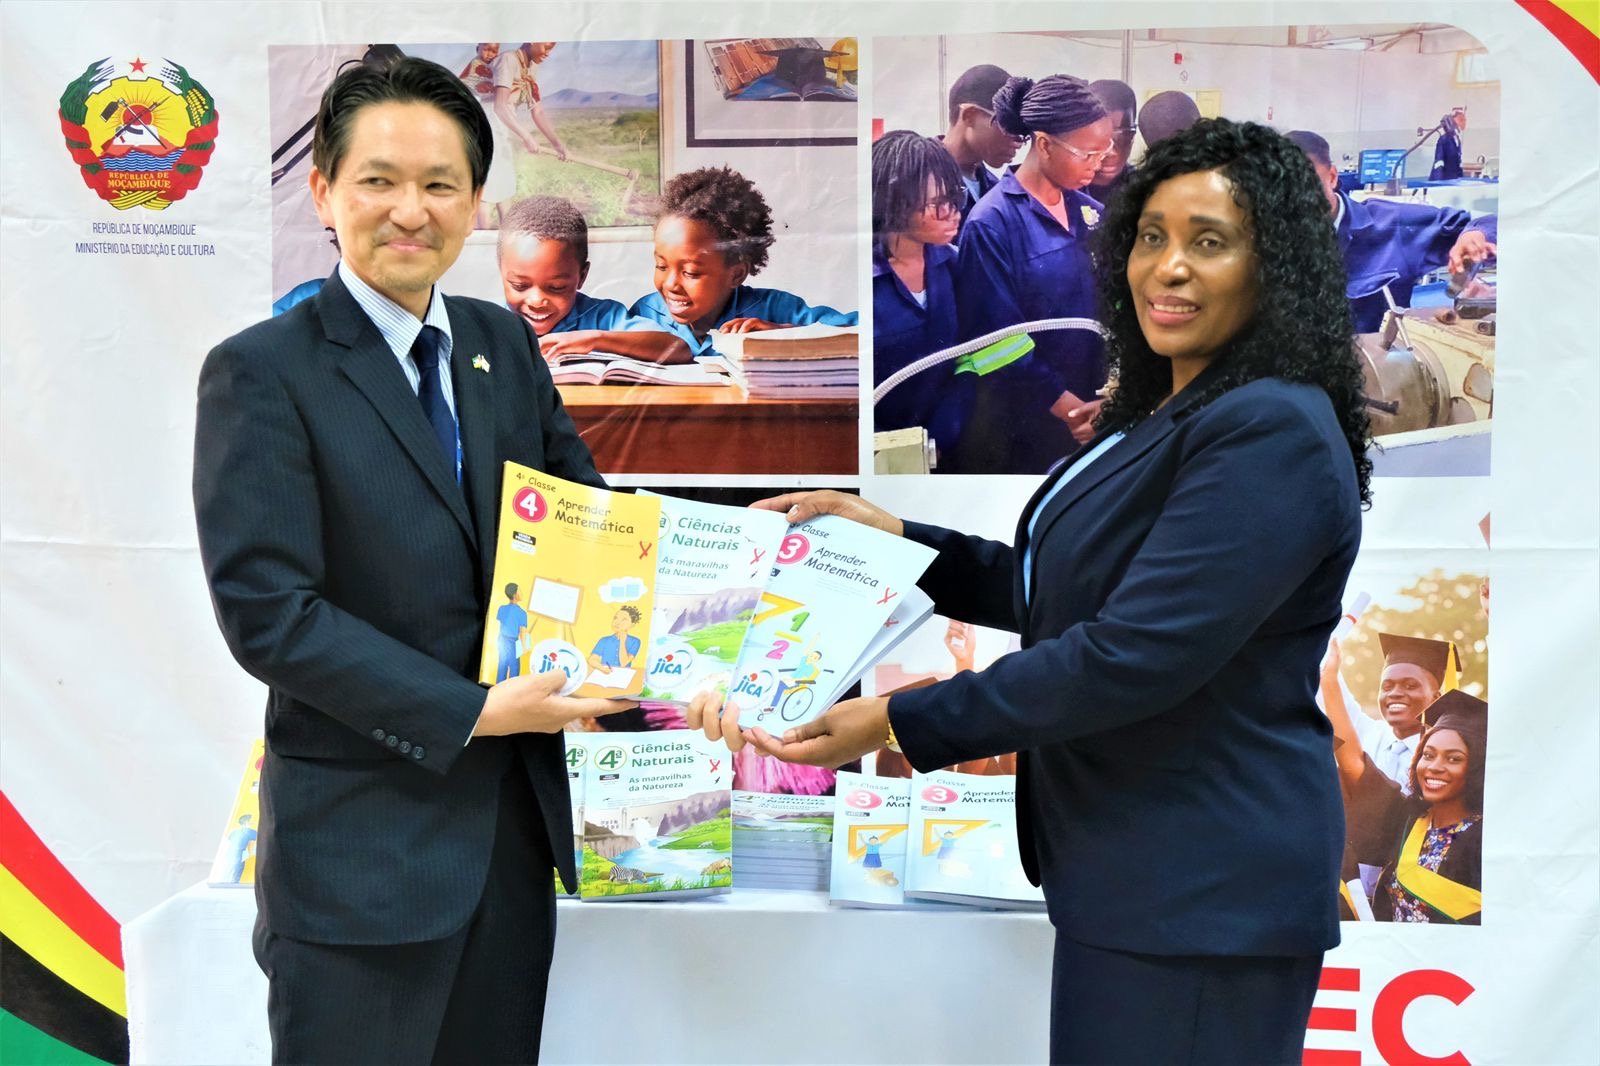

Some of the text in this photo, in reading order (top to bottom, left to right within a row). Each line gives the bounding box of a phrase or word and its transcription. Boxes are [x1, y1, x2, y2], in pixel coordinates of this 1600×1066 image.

[109, 171, 169, 180] REPÚBLICA DE
[107, 179, 171, 189] MOÇAMBIQUE
[92, 221, 196, 237] REPÚBLICA DE MOÇAMBIQUE
[75, 241, 216, 257] MINISTÉRIO DA EDUCAÇÃO E CULTURA
[528, 476, 557, 493] Classe
[519, 492, 538, 518] 4
[557, 497, 612, 517] Aprender
[554, 510, 635, 534] Matemática
[677, 516, 742, 535] Ciências
[801, 523, 830, 539] Classe
[671, 533, 740, 551] Naturais
[778, 538, 803, 559] 3
[661, 556, 730, 570] As maravilhas
[814, 546, 867, 568] Aprender
[658, 566, 717, 580] da Natureza
[803, 557, 880, 588] Matemática
[631, 742, 691, 755] Ciências
[631, 754, 695, 768] Naturais
[628, 776, 640, 784] As
[641, 773, 692, 783] maravilhas
[628, 781, 684, 792] da Natureza
[855, 792, 872, 806] 3
[931, 787, 948, 802] 3
